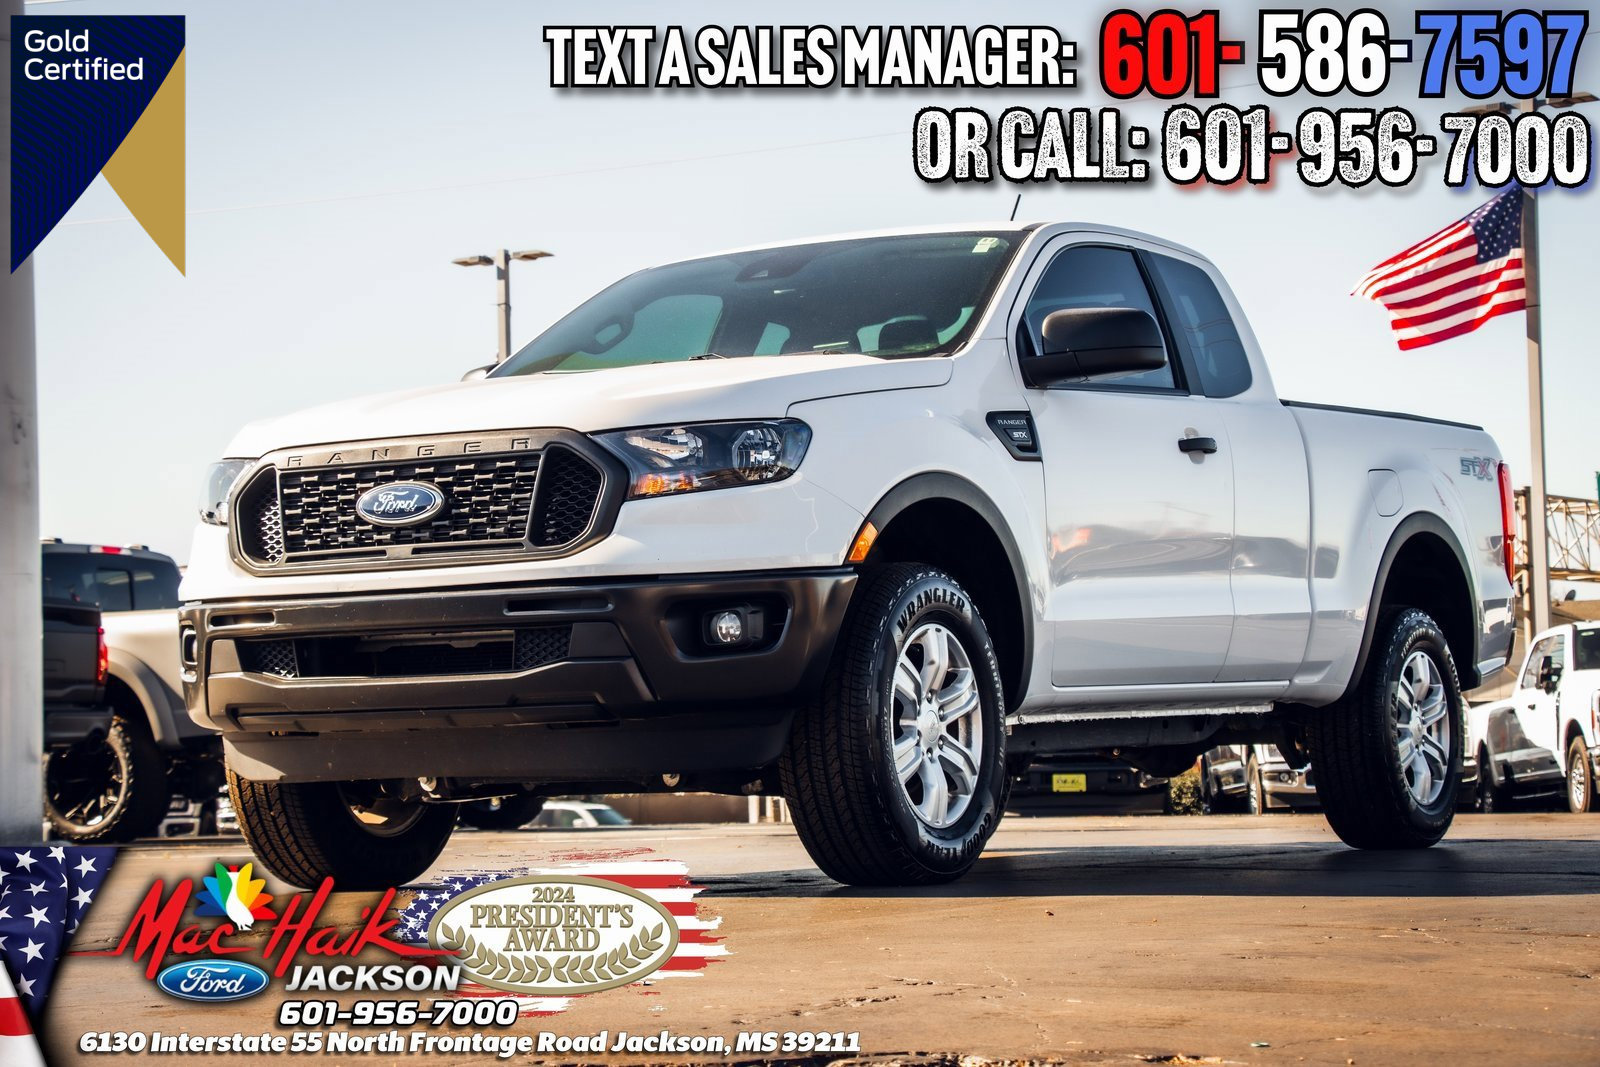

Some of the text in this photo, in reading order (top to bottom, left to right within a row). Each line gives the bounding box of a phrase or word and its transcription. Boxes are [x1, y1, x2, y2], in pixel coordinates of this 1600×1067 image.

[1012, 431, 1028, 439] STX
[287, 437, 532, 467] RANGER
[1460, 456, 1494, 481] STX
[371, 490, 419, 515] Ford
[896, 587, 966, 634] WRANGLER
